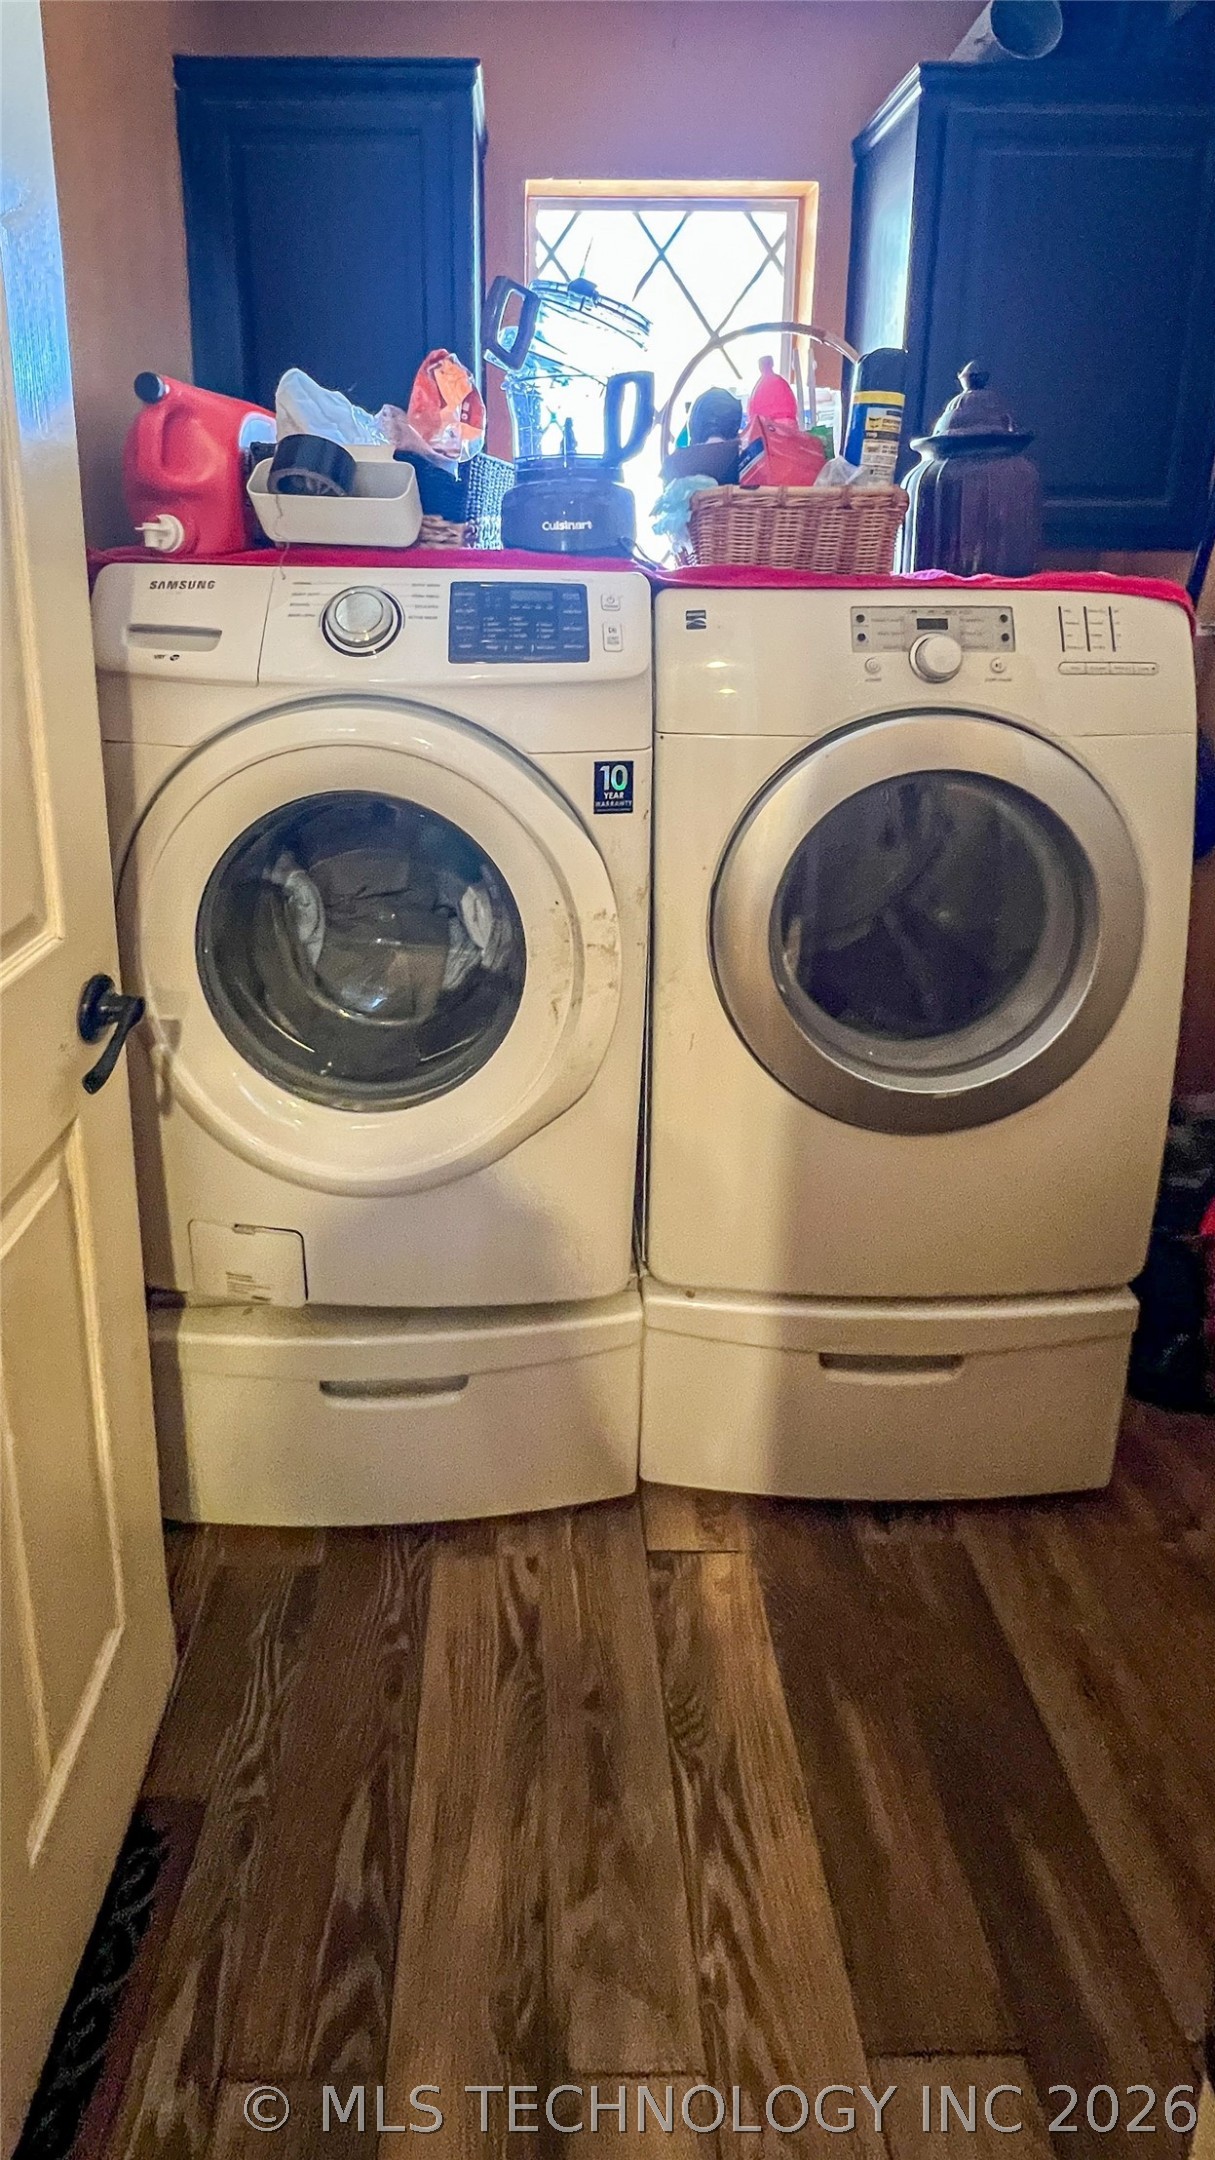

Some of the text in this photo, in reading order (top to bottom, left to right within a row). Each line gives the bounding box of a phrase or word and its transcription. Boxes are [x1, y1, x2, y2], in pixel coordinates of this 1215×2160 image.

[541, 520, 593, 531] Cuisinart
[149, 580, 216, 590] SAMSUNG
[599, 764, 628, 791] 10
[603, 791, 624, 800] YEAR
